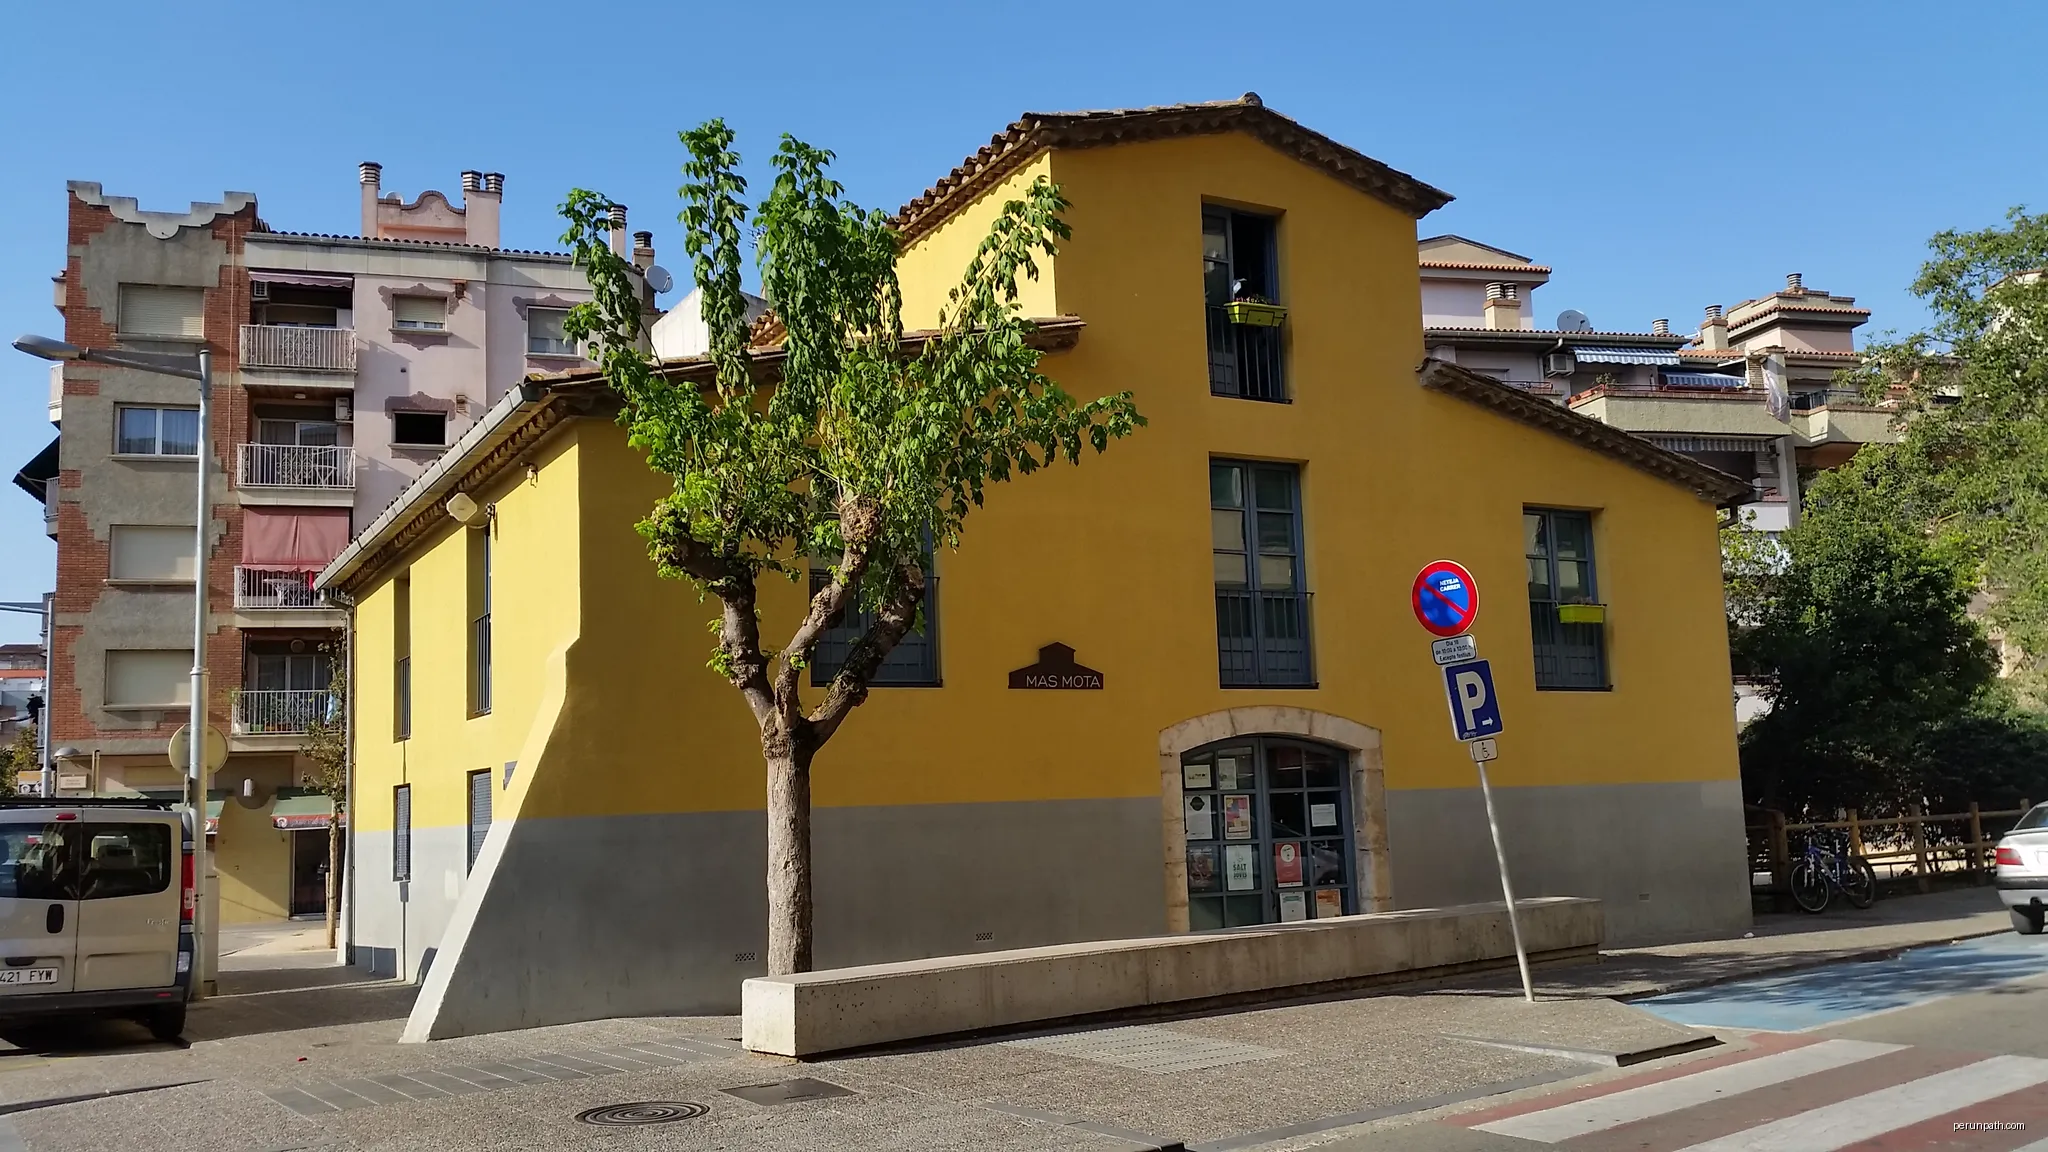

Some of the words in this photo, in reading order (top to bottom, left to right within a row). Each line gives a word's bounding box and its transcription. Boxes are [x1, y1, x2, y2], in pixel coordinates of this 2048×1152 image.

[1026, 675, 1058, 688] MAS
[1062, 675, 1101, 688] MOTA
[1456, 671, 1486, 730] P
[29, 970, 53, 981] FYW
